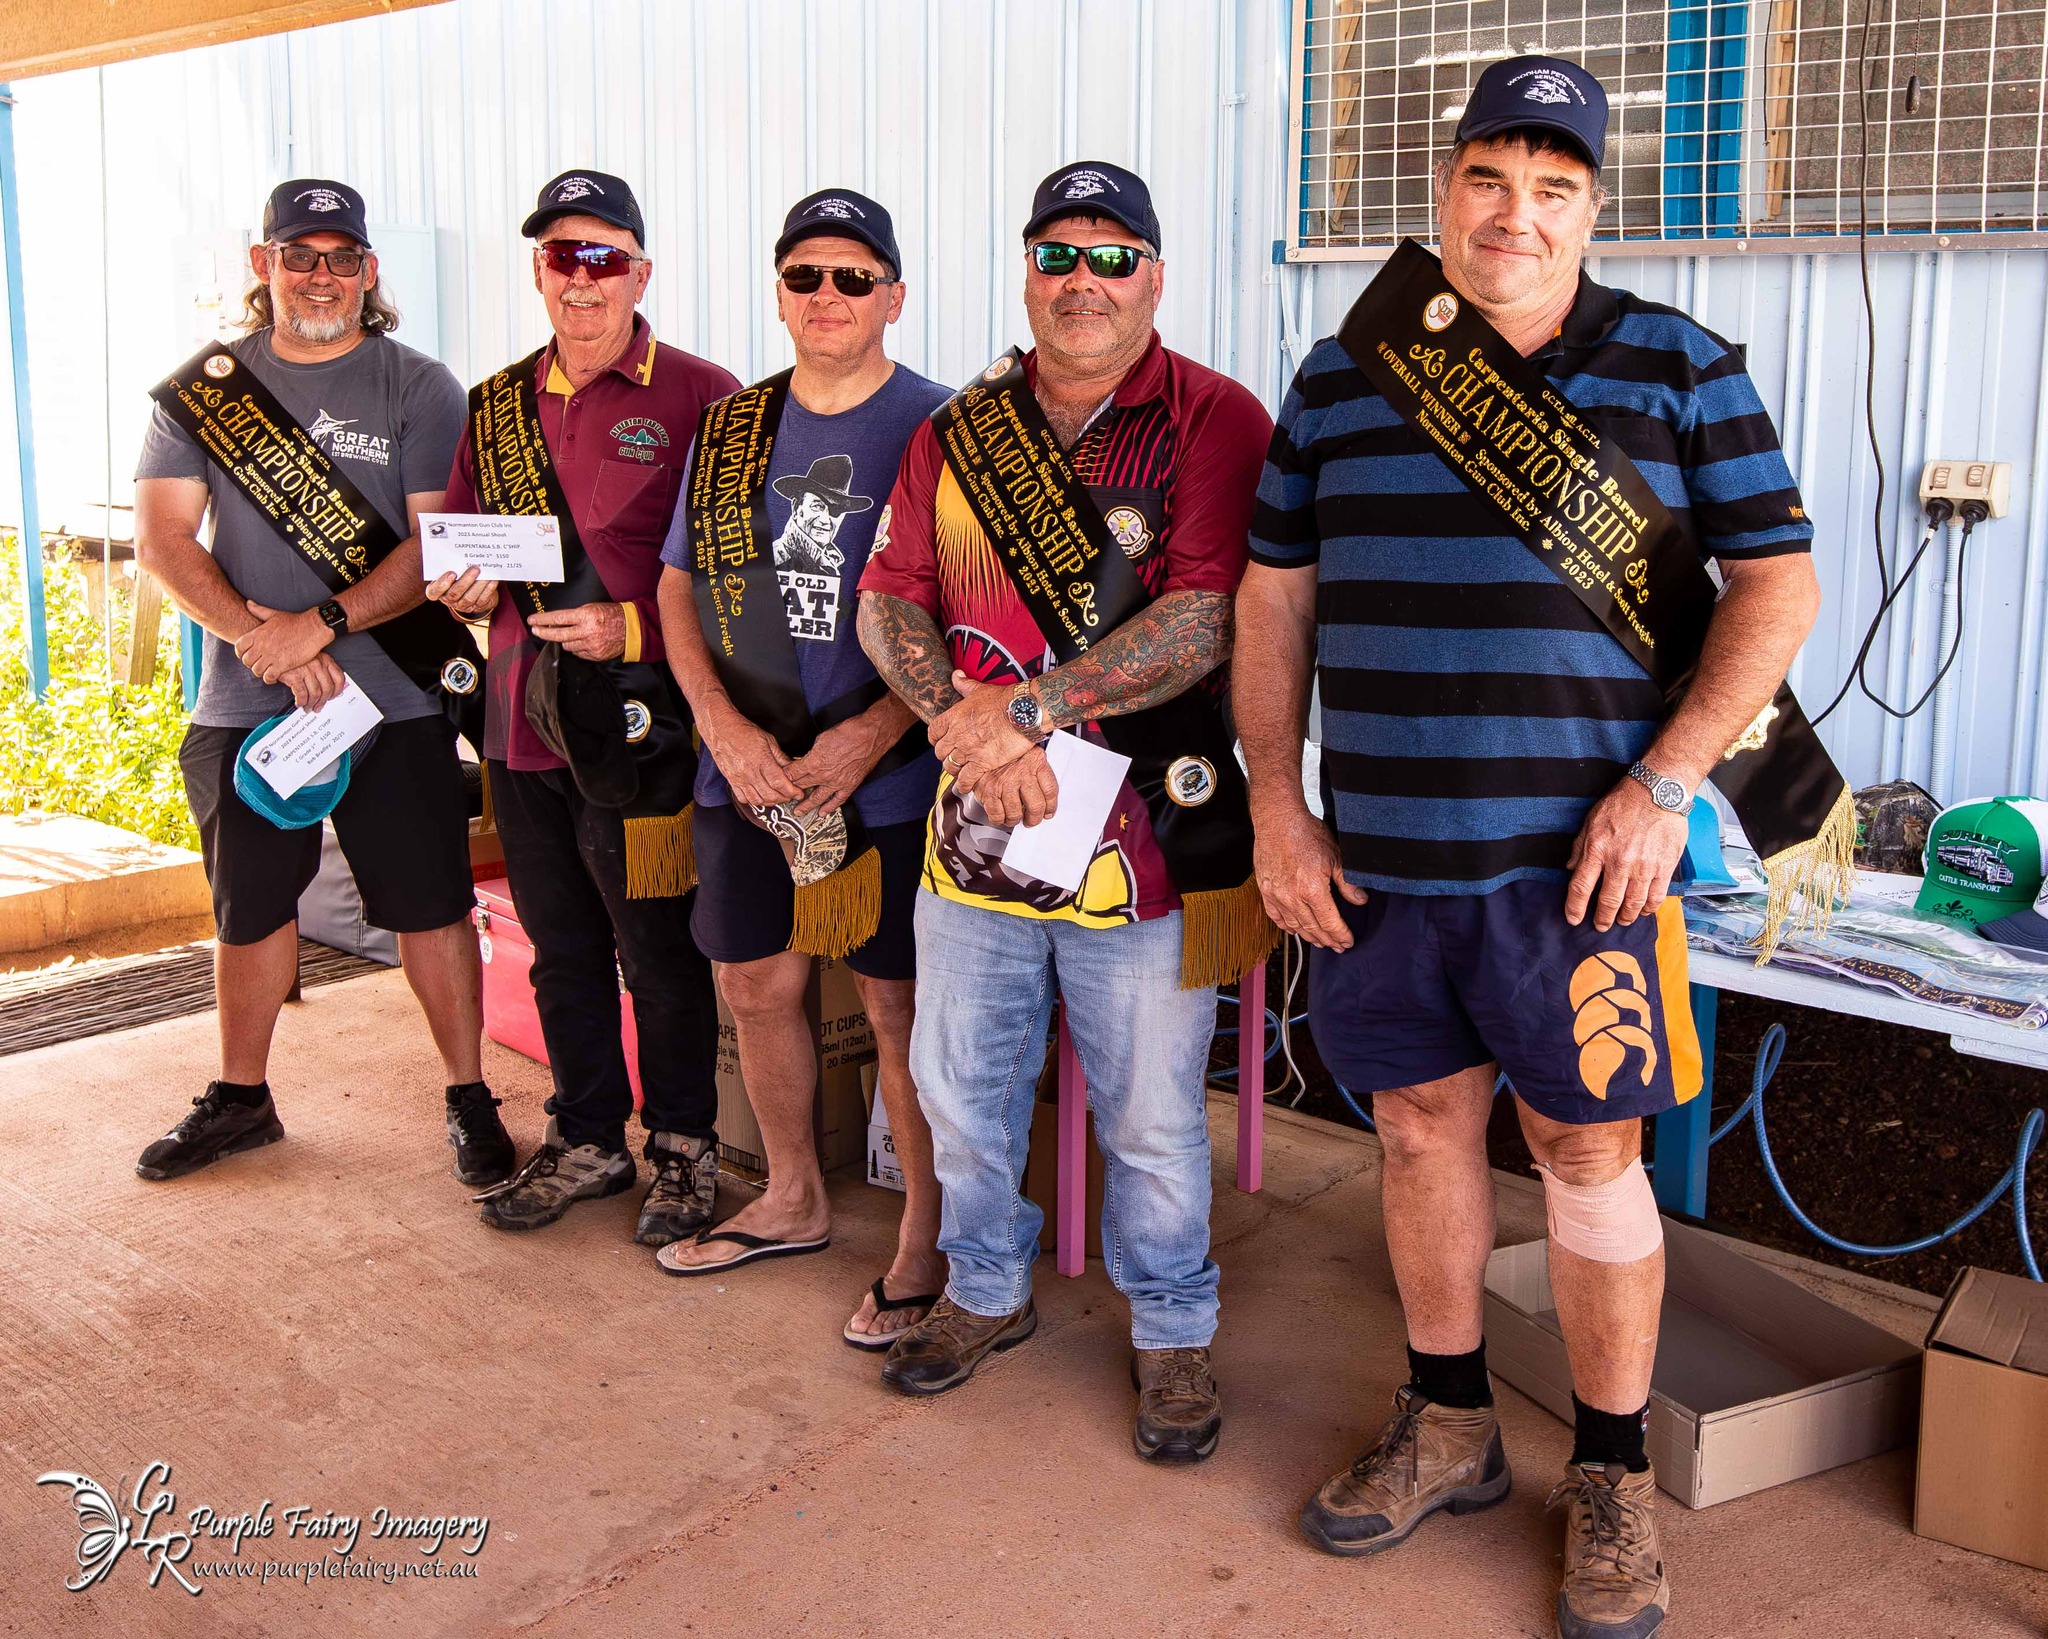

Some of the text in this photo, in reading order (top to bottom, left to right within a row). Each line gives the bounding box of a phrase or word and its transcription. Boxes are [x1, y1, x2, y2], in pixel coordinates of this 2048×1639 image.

[1534, 74, 1567, 88] SERVICES
[1550, 69, 1587, 106] PETROLEUM
[1084, 170, 1121, 193] PETROLEUM
[1382, 349, 1461, 436] OVERALL WINNER
[177, 390, 236, 452] GRADE WINNER
[513, 380, 529, 447] Carpentaria
[523, 446, 540, 487] Single
[610, 417, 643, 439] ATHERTON
[948, 396, 978, 457] RADE WINNER
[332, 442, 389, 460] NORTHERN
[333, 430, 390, 451] GREAT
[340, 454, 370, 462] BREWING
[475, 410, 484, 451] Normanton
[481, 468, 490, 488] Club
[494, 387, 540, 516] CHAMPIONSH
[619, 447, 654, 461] GUN CLUB
[699, 446, 709, 466] Gun
[1468, 347, 1649, 534] Carpentaria Single Barrel
[217, 402, 356, 544] CHAMPIONSHIP
[242, 394, 366, 530] Carpentaria Single Barrel
[486, 447, 502, 501] Sponsored by
[694, 467, 705, 490] Club
[714, 389, 759, 566] CHAMPIONSHIP
[738, 387, 774, 560] Carpentaria Single Barrel
[999, 389, 1100, 560] Carpentaria Single Barrel
[1441, 363, 1637, 561] CHAMPIONSHIP
[197, 427, 321, 561] Normanton Gun Club Inc. 2023
[970, 398, 1085, 576] CHAMPIONSHIP
[1415, 409, 1595, 590] Normanton Gun Club Inc. 2023
[245, 463, 339, 567] Sponsored by Albion Hotel &
[945, 427, 969, 473] Normanton
[966, 472, 980, 495] Gun
[978, 493, 996, 519] Club
[1018, 565, 1041, 596] 2023
[696, 540, 707, 569] 2023
[700, 447, 734, 657] Sponsored by Albion Hotel & Scott Freight
[981, 472, 1080, 637] Sponsored by Albion Hotel & Scott
[1476, 449, 1655, 649] Sponsored by Albion Hotel & Scott Freight
[795, 577, 827, 590] OLD
[782, 588, 836, 619] AT
[268, 718, 301, 748] Normanton Gun
[304, 716, 318, 728] Shoot
[283, 735, 311, 762] CARPENTARIA
[299, 747, 312, 761] Grade
[315, 744, 332, 758] Bradley
[1939, 874, 2002, 893] CATTLE TRANSPORT
[837, 1012, 867, 1033] CUPS
[842, 1034, 867, 1051] (12oz)
[724, 1062, 734, 1075] 25
[826, 1056, 838, 1069] 20
